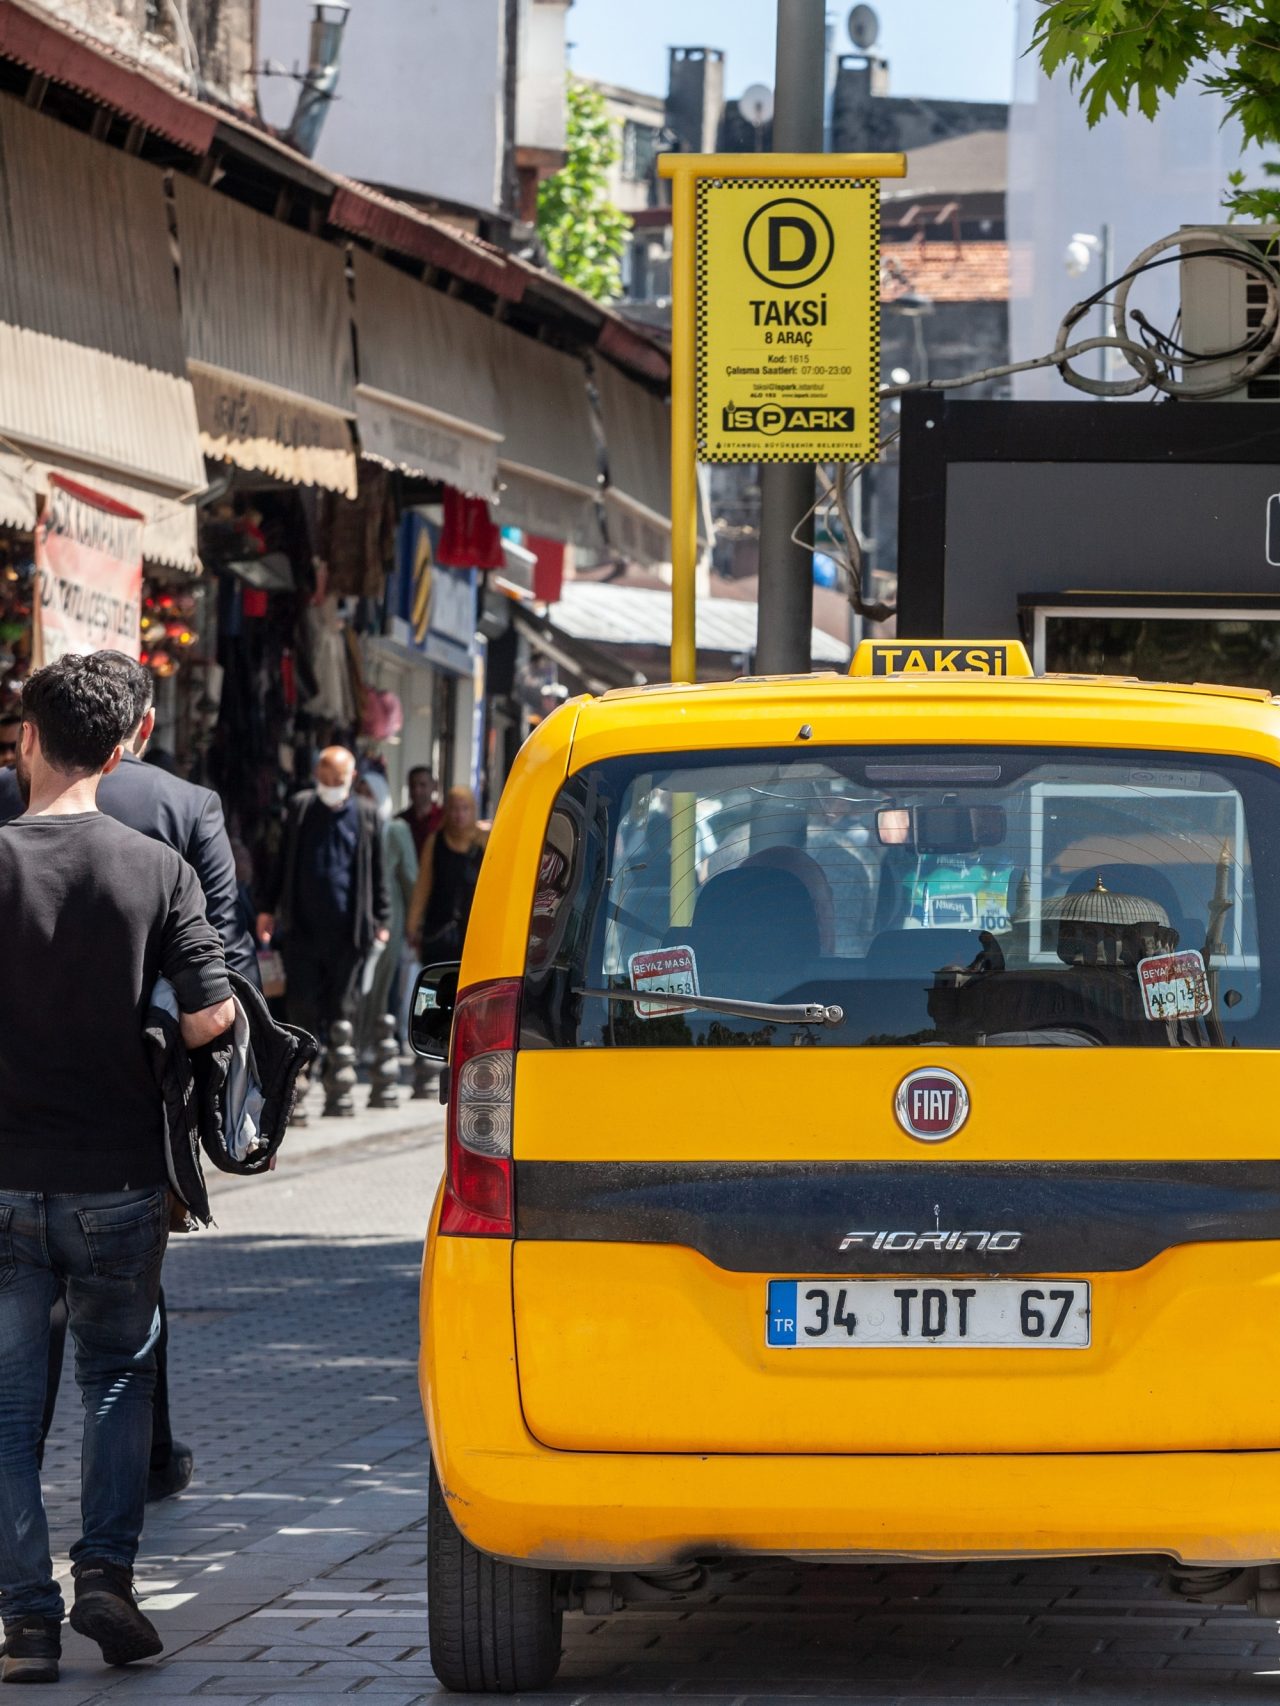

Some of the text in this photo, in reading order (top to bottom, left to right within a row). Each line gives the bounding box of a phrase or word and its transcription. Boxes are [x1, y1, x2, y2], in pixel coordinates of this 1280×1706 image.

[768, 217, 817, 271] D
[749, 293, 827, 326] TAKSİ
[765, 331, 813, 347] 8 ARAÇ
[768, 354, 809, 363] Kod: 1615
[762, 366, 798, 375] Saatleri:
[801, 366, 852, 375] 07:00-23:00
[634, 958, 691, 973] BEYAZ MASA
[1151, 991, 1175, 1006] ALO
[913, 1090, 953, 1120] FIAT
[839, 1231, 1024, 1250] FIORINO
[804, 1289, 1075, 1337] 34 TDT 67
[775, 1318, 793, 1332] TR
